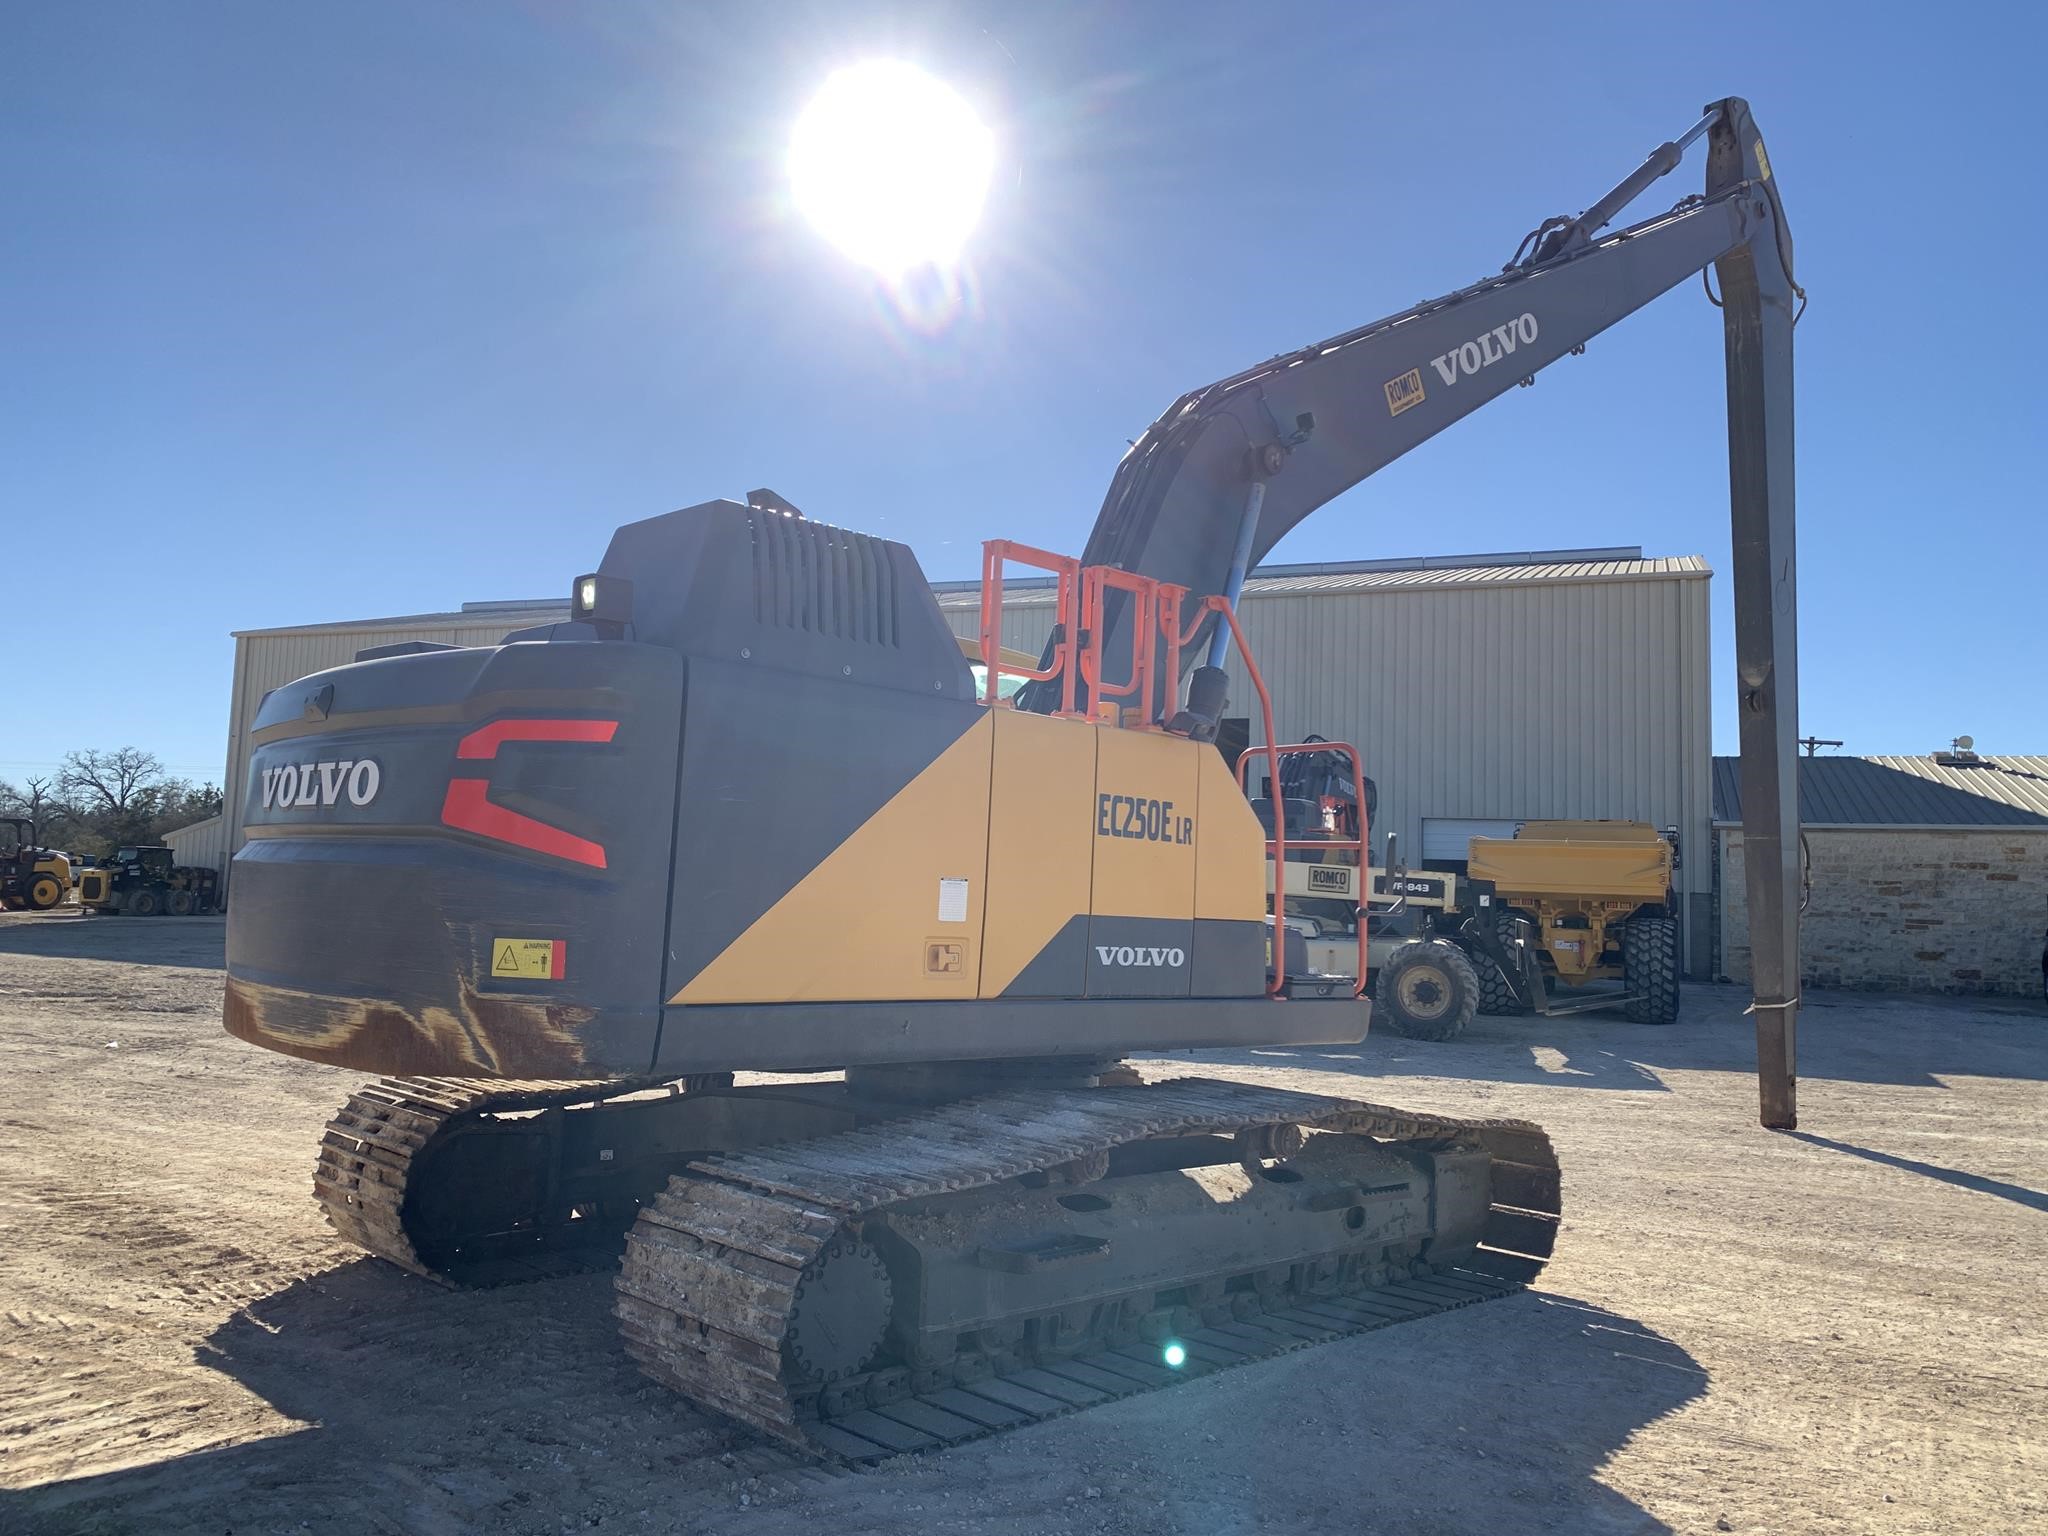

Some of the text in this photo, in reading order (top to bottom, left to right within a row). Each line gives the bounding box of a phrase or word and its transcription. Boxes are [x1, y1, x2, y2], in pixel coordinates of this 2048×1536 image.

[1430, 312, 1538, 386] VOLVO
[1387, 371, 1420, 405] ROMCO
[262, 759, 380, 808] VOLVO
[1098, 793, 1192, 845] EC250E LR
[1312, 870, 1346, 885] ROMCO
[1095, 946, 1185, 967] VOLVO
